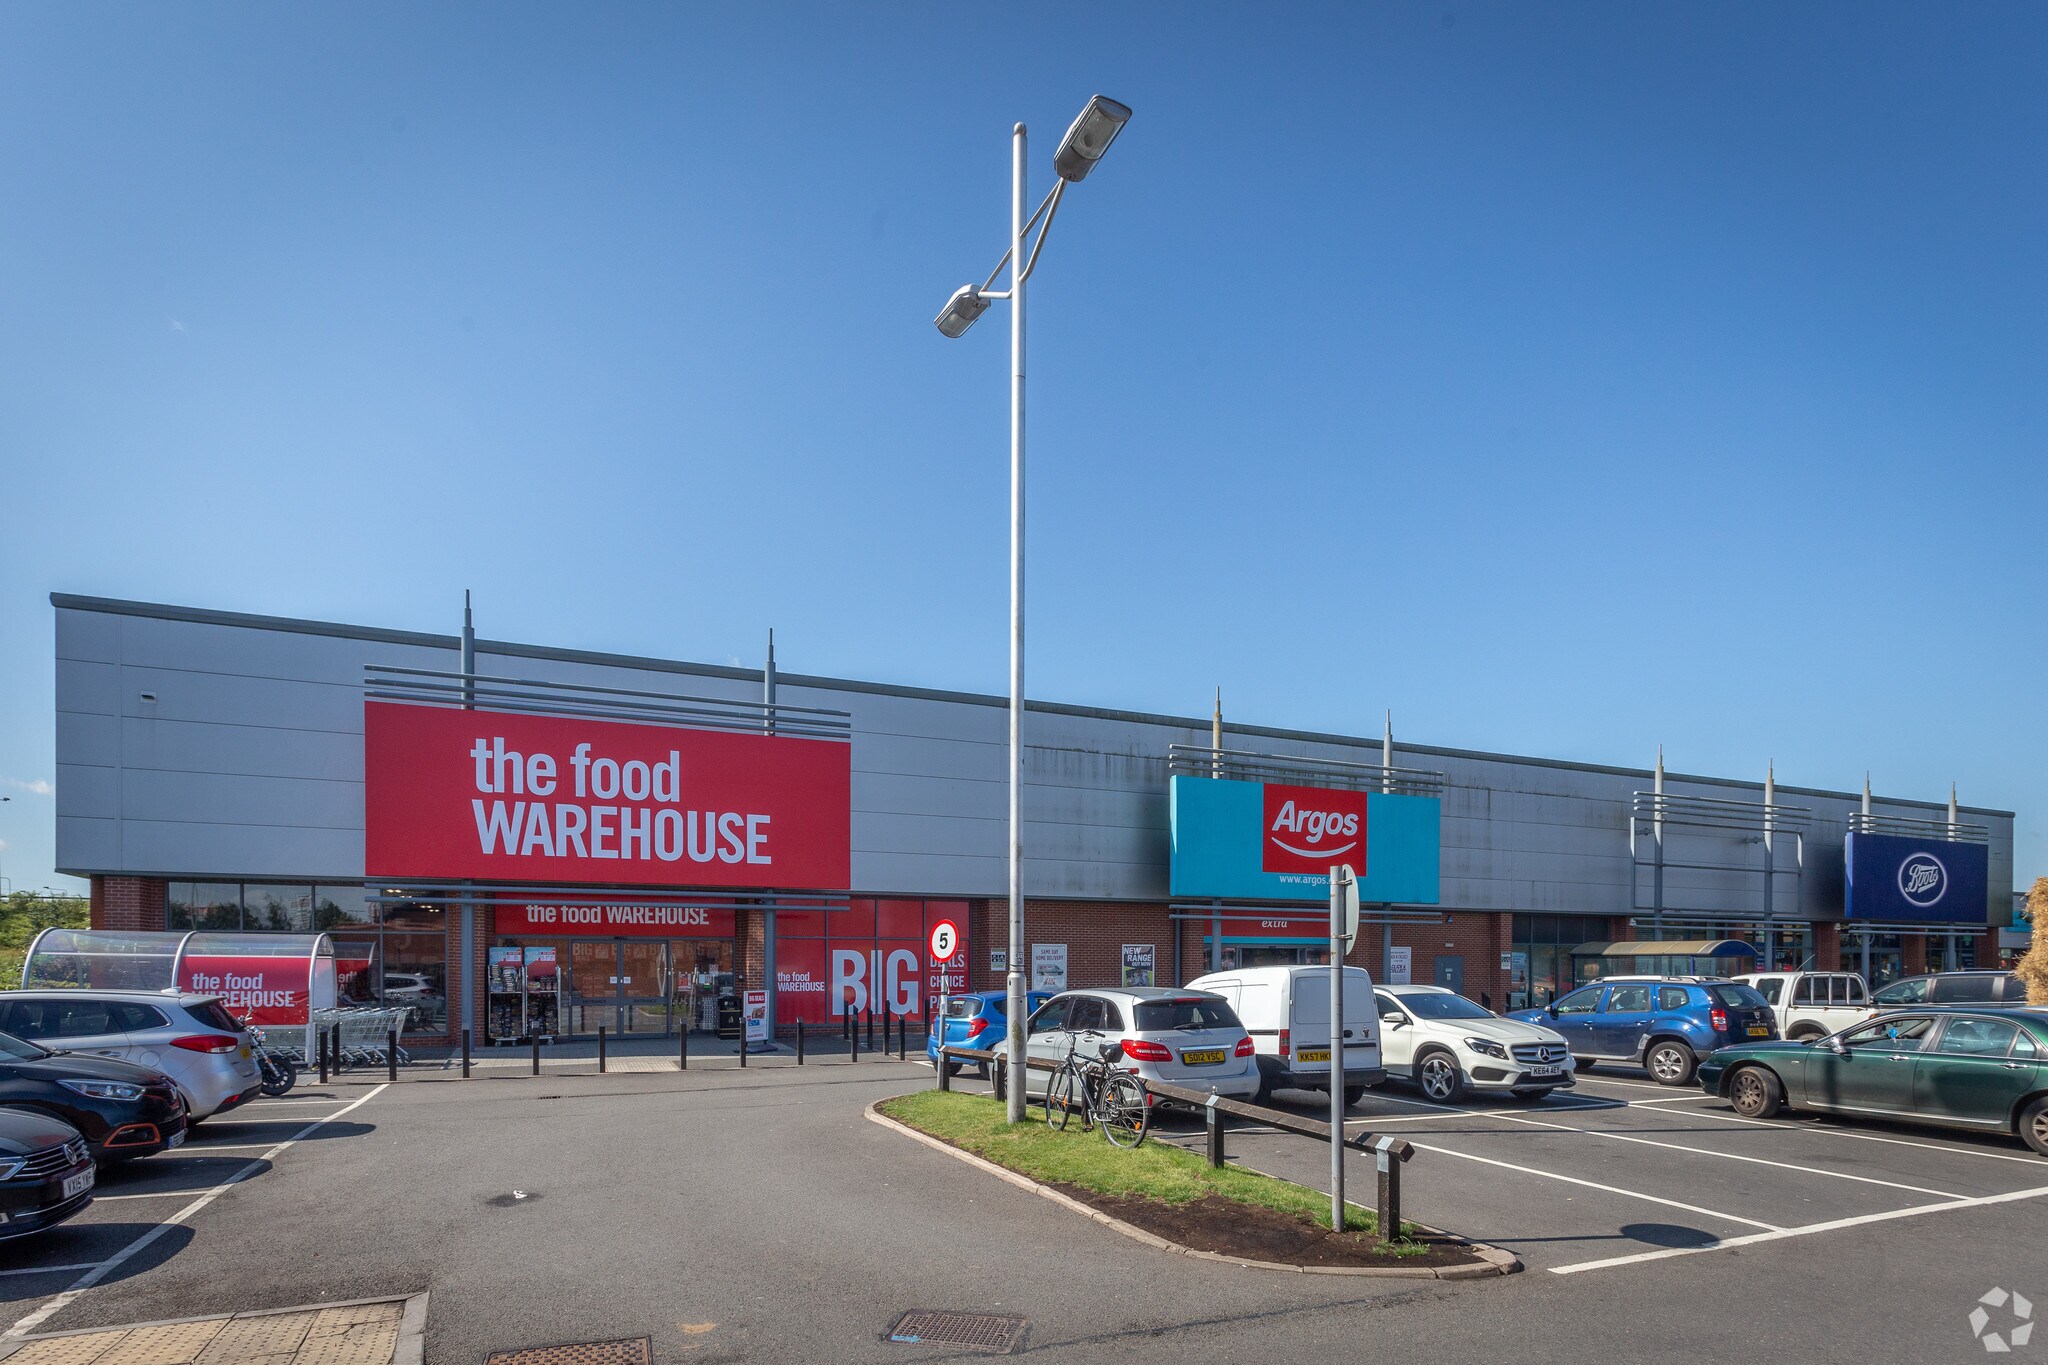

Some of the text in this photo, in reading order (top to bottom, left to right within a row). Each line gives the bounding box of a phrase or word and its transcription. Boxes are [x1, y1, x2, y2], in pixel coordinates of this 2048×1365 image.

[471, 737, 680, 803] the food
[1271, 800, 1359, 843] Argos
[472, 799, 772, 865] WAREHOUSE
[1905, 864, 1938, 893] Boots
[526, 905, 710, 925] the food WAREHOUSE
[1261, 920, 1288, 928] extra
[939, 932, 948, 950] 5
[930, 954, 965, 968] DLS
[1127, 954, 1152, 962] RANGE
[192, 972, 263, 990] the food
[777, 971, 810, 982] the food
[832, 949, 919, 1016] BIG
[930, 975, 965, 988] CHICE
[777, 981, 825, 992] WAREHOUSE
[192, 990, 295, 1008] REHOUSE
[1188, 1052, 1220, 1062] SO12 VSC
[1300, 1052, 1319, 1061] KK57
[1533, 1067, 1549, 1075] KE64
[67, 1177, 81, 1194] VX15
